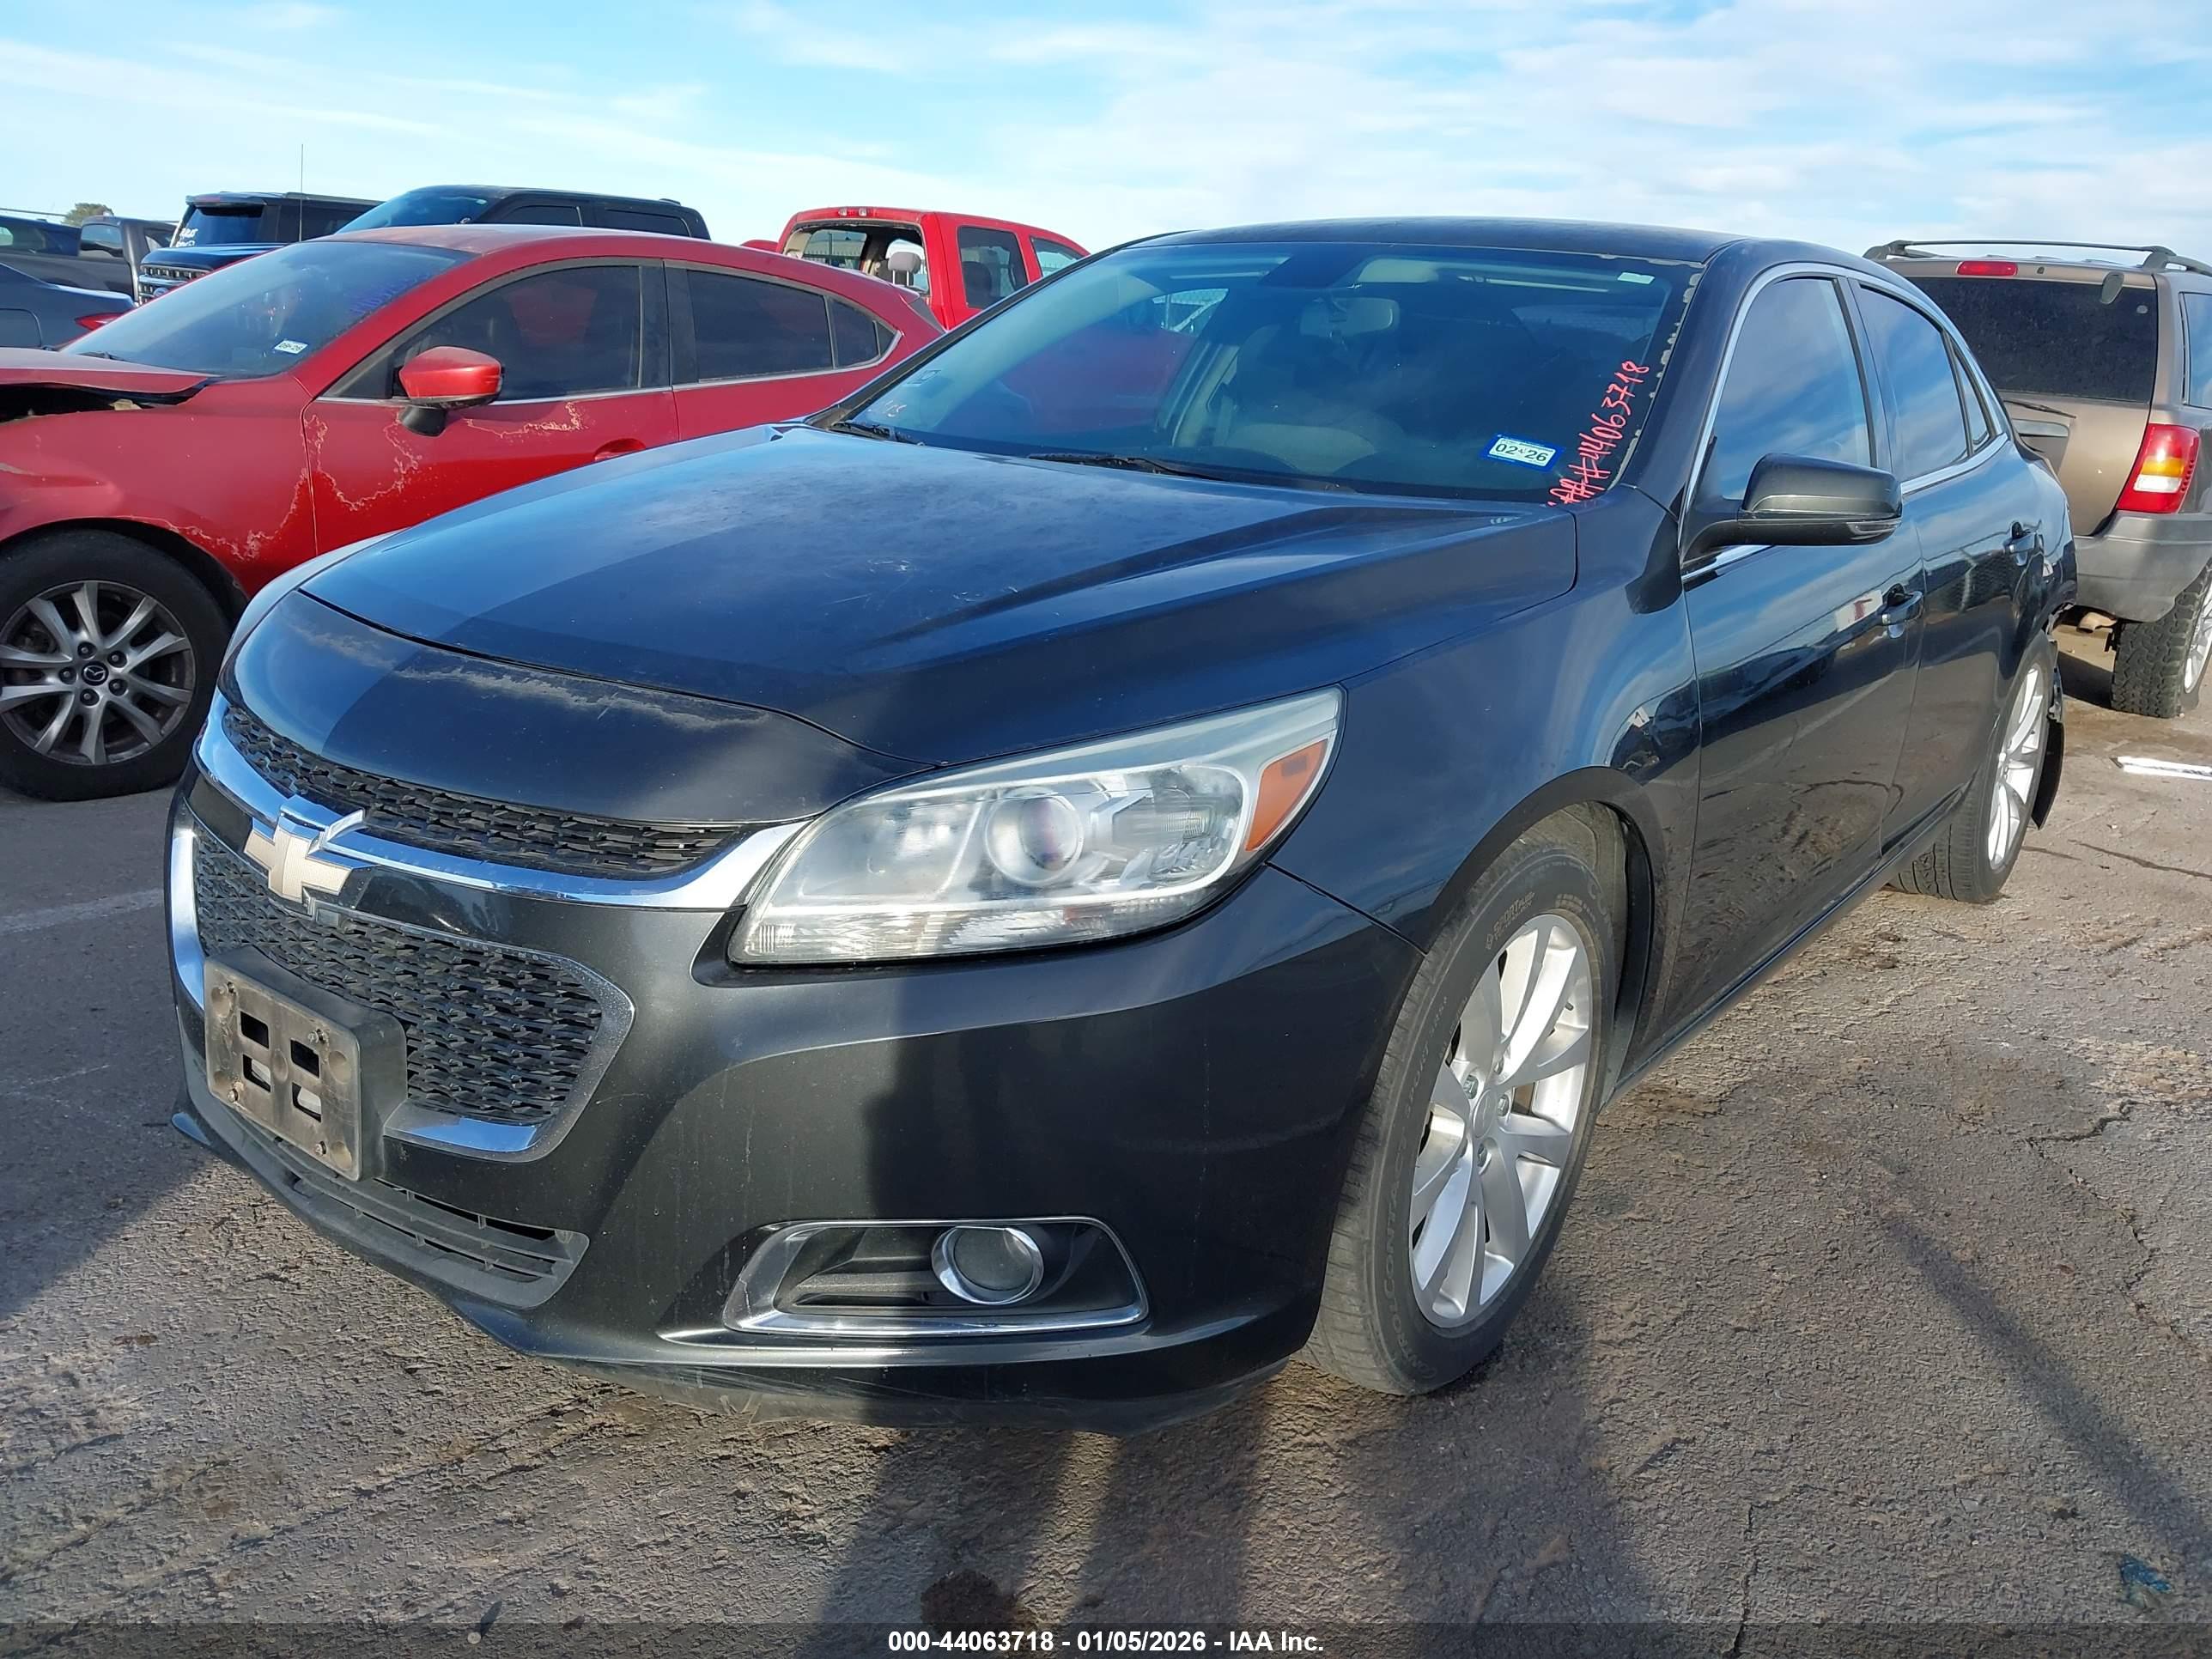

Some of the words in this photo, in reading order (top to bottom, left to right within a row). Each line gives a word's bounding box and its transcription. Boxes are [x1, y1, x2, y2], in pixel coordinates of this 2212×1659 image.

[1495, 443, 1518, 455] 02
[1524, 450, 1549, 462] 26
[1547, 360, 1650, 506] AA#44063718
